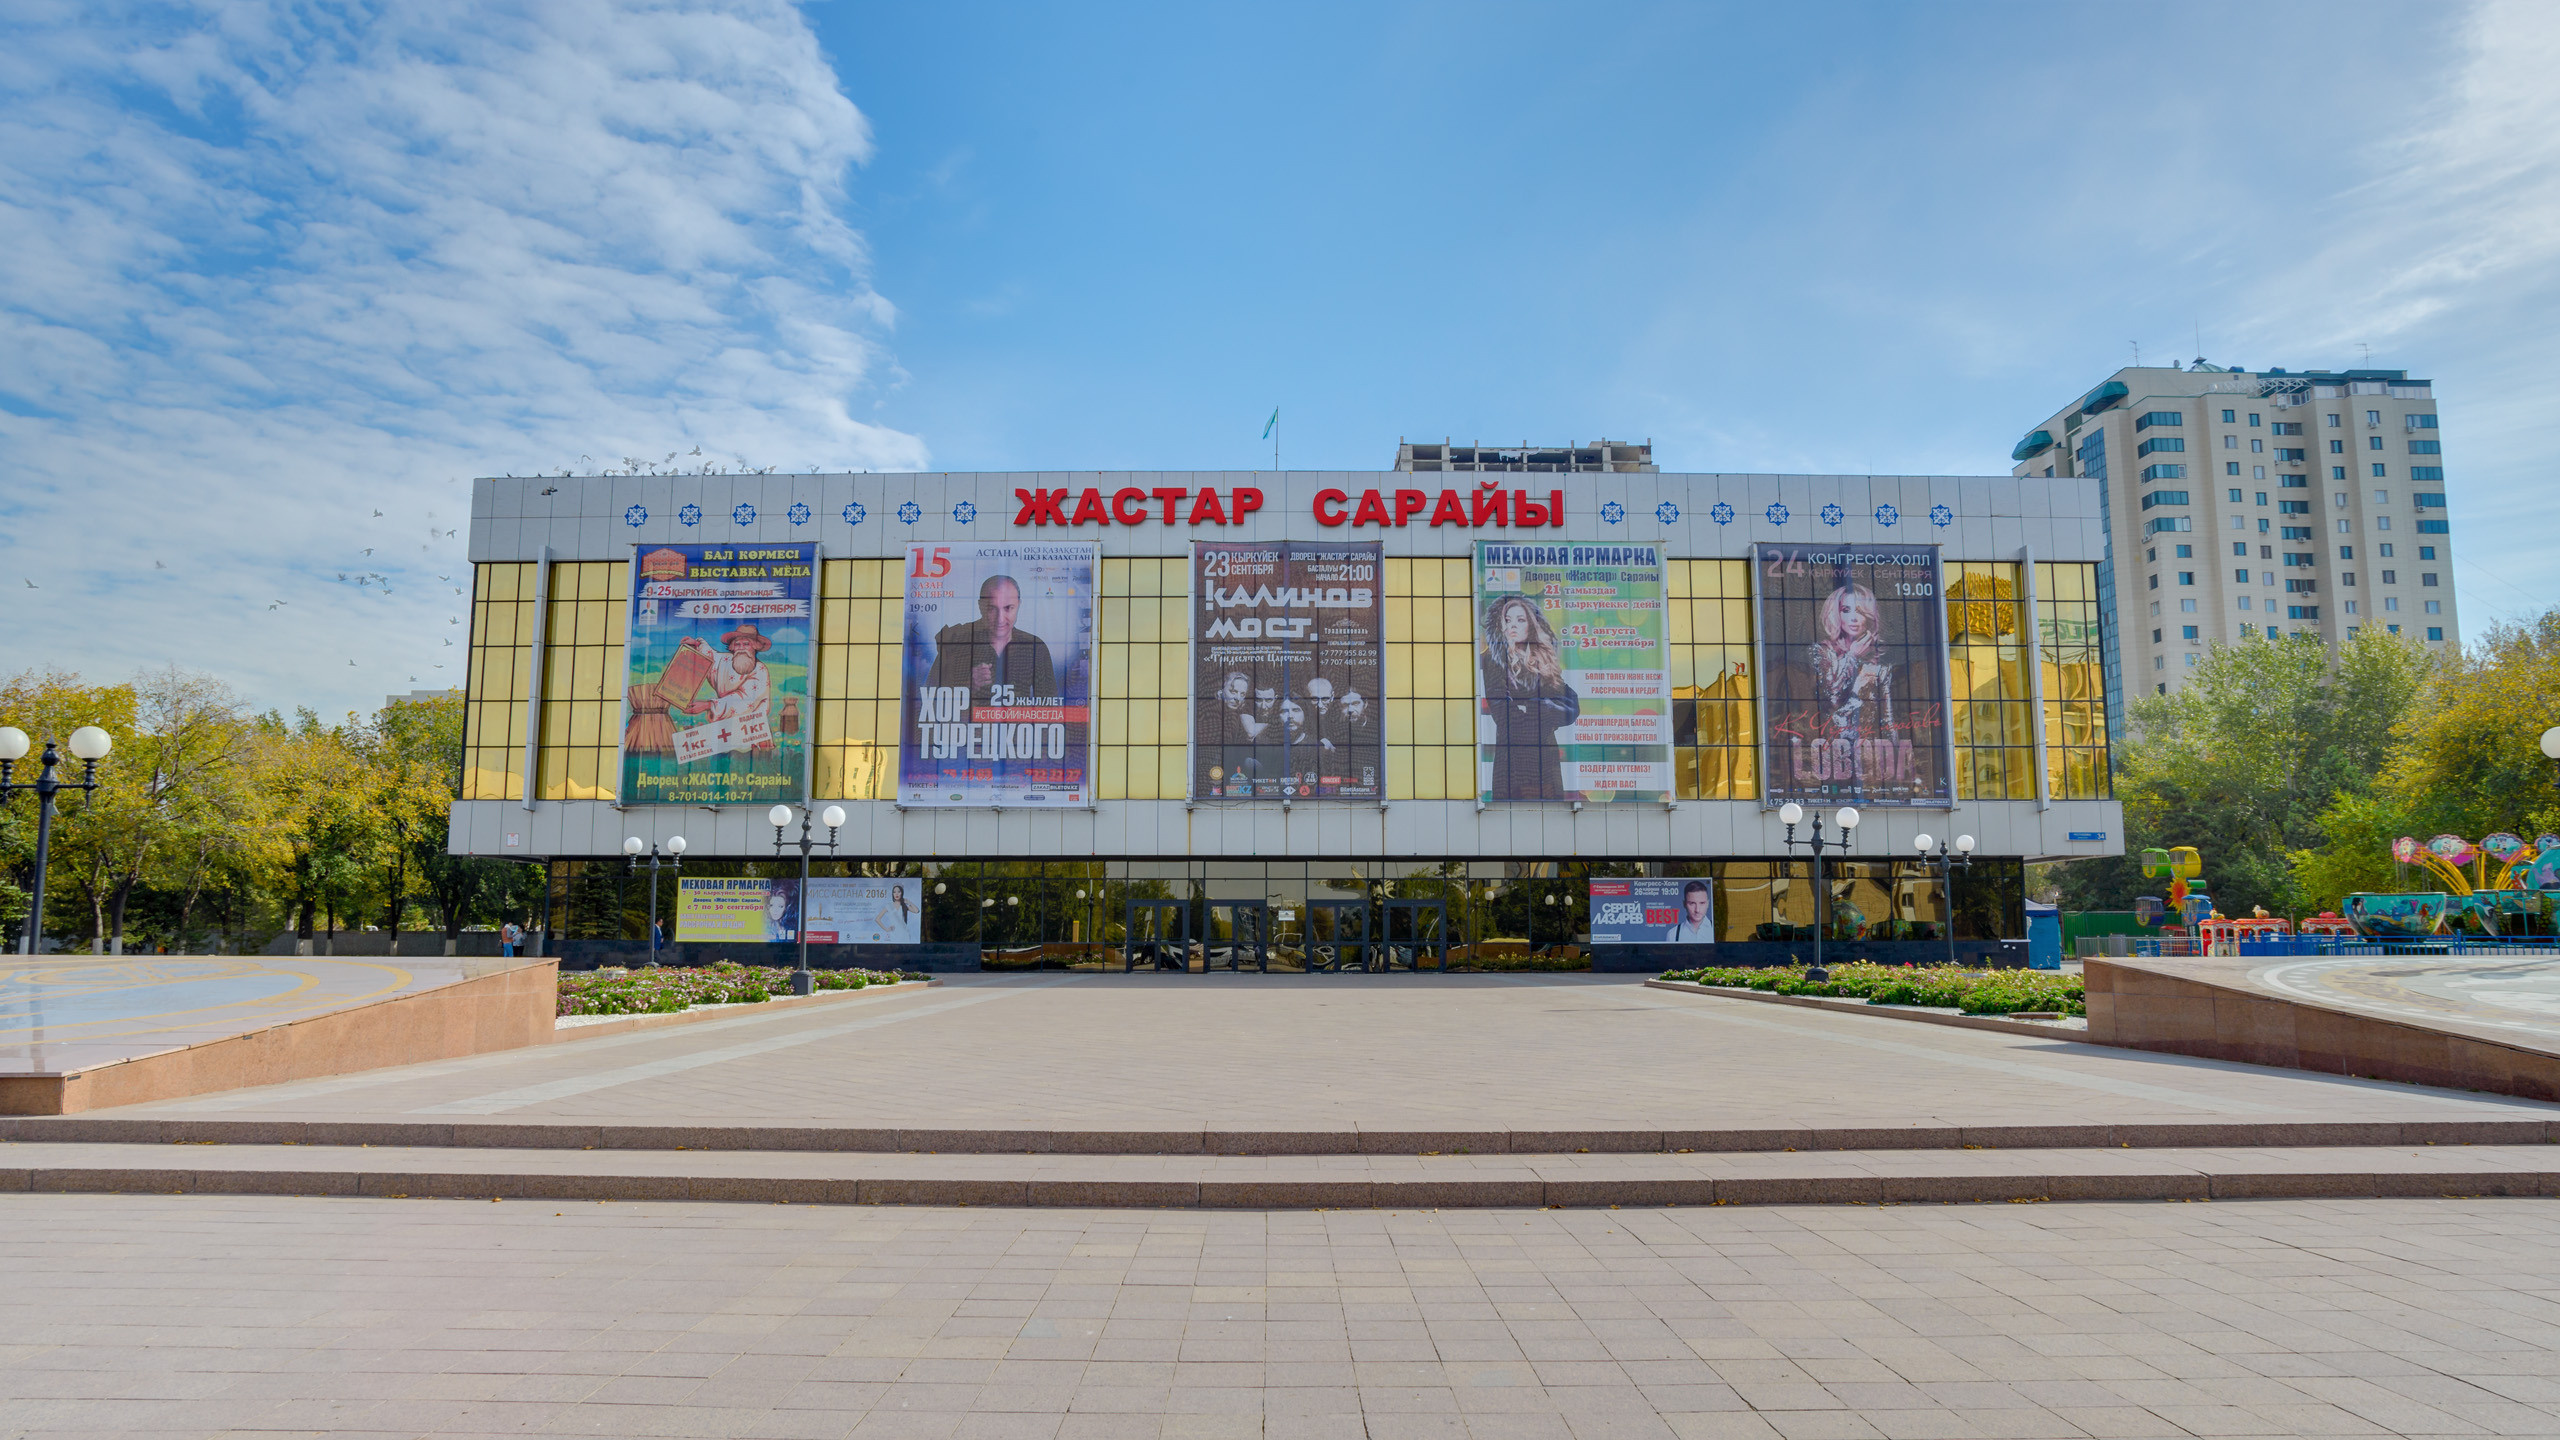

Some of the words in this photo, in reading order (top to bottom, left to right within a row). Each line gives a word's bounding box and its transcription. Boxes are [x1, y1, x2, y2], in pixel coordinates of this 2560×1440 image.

[1014, 487, 1264, 526] ЖАСТАР
[1313, 481, 1563, 527] САРАЙЫ
[704, 550, 733, 560] БАЛ
[739, 550, 799, 560] КӨРМЕСІ
[976, 549, 1018, 557] АСТАНА
[1290, 552, 1316, 561] ДВОРЕЦ
[1350, 552, 1376, 561] САРАЙЫ
[1486, 547, 1569, 566] МЕХОВАЯ
[1573, 547, 1657, 566] ЯРМАРКА
[911, 547, 951, 579] 15
[1204, 551, 1230, 577] 23
[1767, 550, 1804, 578] 24
[1808, 553, 1930, 566] КОНГРЕСС-ХОЛЛ
[690, 567, 767, 578] ВЫСТАВКА
[772, 564, 811, 577] МЁДА
[1231, 564, 1273, 575] СЕНТЯБРЯ
[1339, 565, 1373, 582] 21:00
[1874, 569, 1931, 579] СЕНТЯБРЯ
[1525, 571, 1561, 582] Дворец
[1566, 570, 1617, 583] «Жастар»
[1620, 572, 1659, 582] Сарайы
[1545, 584, 1560, 595] 21
[1565, 587, 1616, 596] тамыздан
[1895, 583, 1932, 596] 19.00
[703, 604, 709, 614] 9
[712, 604, 726, 613] ПО
[729, 602, 744, 614] 25
[745, 604, 796, 613] СЕНТЯБРЯ
[910, 604, 937, 612] 19:00
[1544, 599, 1561, 609] 31
[1572, 625, 1588, 635] 21
[1593, 628, 1636, 637] августа
[1582, 637, 1597, 648] 31
[1602, 638, 1654, 648] сентября
[991, 684, 1015, 707] 25
[1016, 697, 1064, 706] ЖЫЛ/ЛЕТ
[1636, 687, 1659, 695] КРЕДИТ
[918, 686, 970, 723] ХОР
[975, 709, 1064, 721] #СТОБОЙИНАВСЕГДА
[918, 723, 1065, 761] ТУРЕЦКОГО
[1604, 733, 1657, 742] ПРОИЗВОДИТЕЛЯ
[1793, 738, 1915, 781] LOBODA
[637, 773, 678, 788] Дворец
[682, 773, 743, 786] «ЖАСТАР»
[746, 773, 791, 788] Сарайы
[1595, 780, 1617, 788] ЖДЕМ
[1619, 780, 1637, 788] ВАС!
[669, 791, 752, 801] 8-701-014-10-71
[681, 879, 724, 890] МЕХОВАЯ
[726, 879, 771, 890] ЯРМАРКА
[831, 889, 863, 898] АСТАНА
[865, 890, 887, 898] 2016!
[1602, 901, 1640, 913] СЕРГЕЙ
[1592, 913, 1644, 924] ЛАЗАРЕВ
[1646, 909, 1679, 924] BEST
